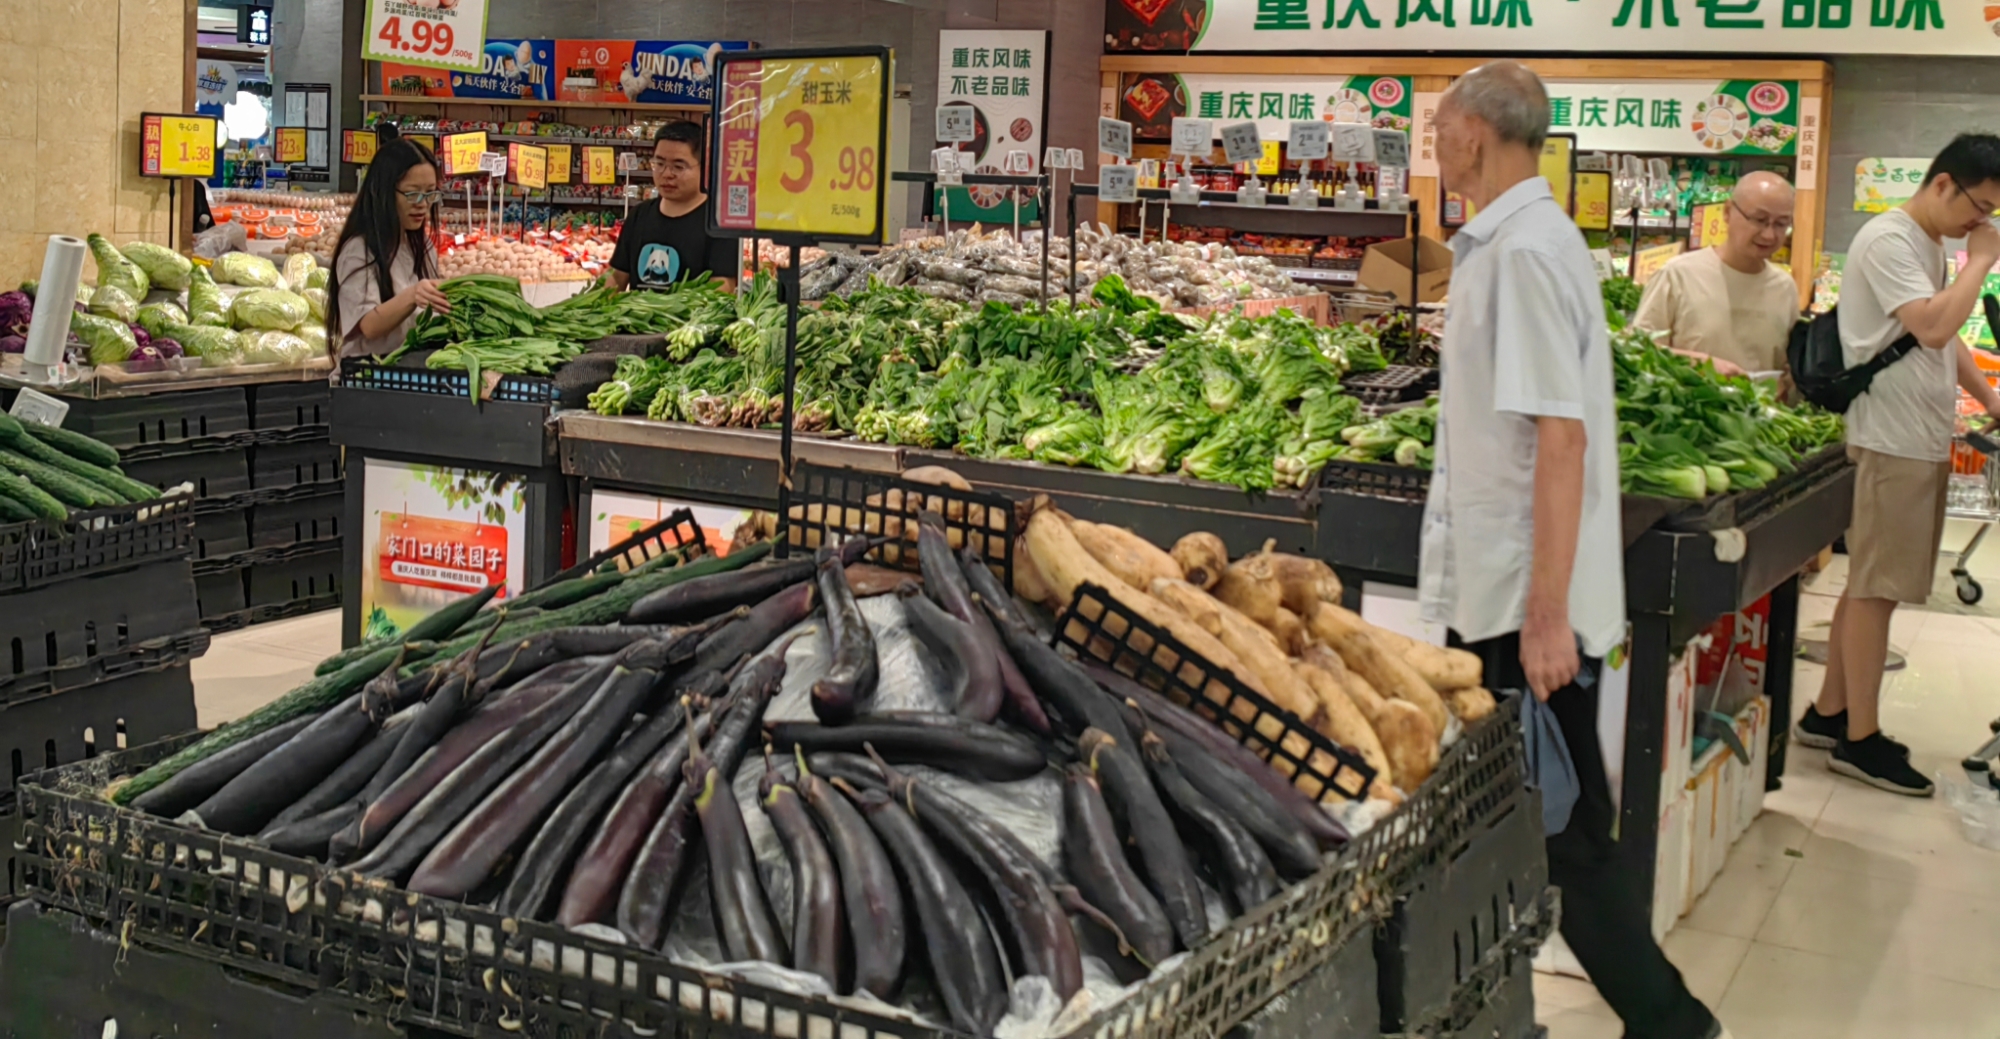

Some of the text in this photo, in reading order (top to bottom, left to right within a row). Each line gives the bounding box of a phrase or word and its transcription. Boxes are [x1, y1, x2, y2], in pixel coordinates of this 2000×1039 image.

[378, 16, 473, 60] 4.99 /500g
[952, 47, 1032, 70] 重庆风味
[801, 81, 852, 105] 甜玉米
[951, 75, 1030, 97] 不老品味
[1198, 91, 1315, 120] 重庆风味
[1549, 97, 1682, 129] 重庆风味
[146, 125, 159, 159] 热卖
[727, 86, 758, 182] 热卖
[1801, 115, 1816, 172] 重庆风味
[179, 142, 210, 162] 1.38
[386, 532, 503, 571] 家门口的菜园子
